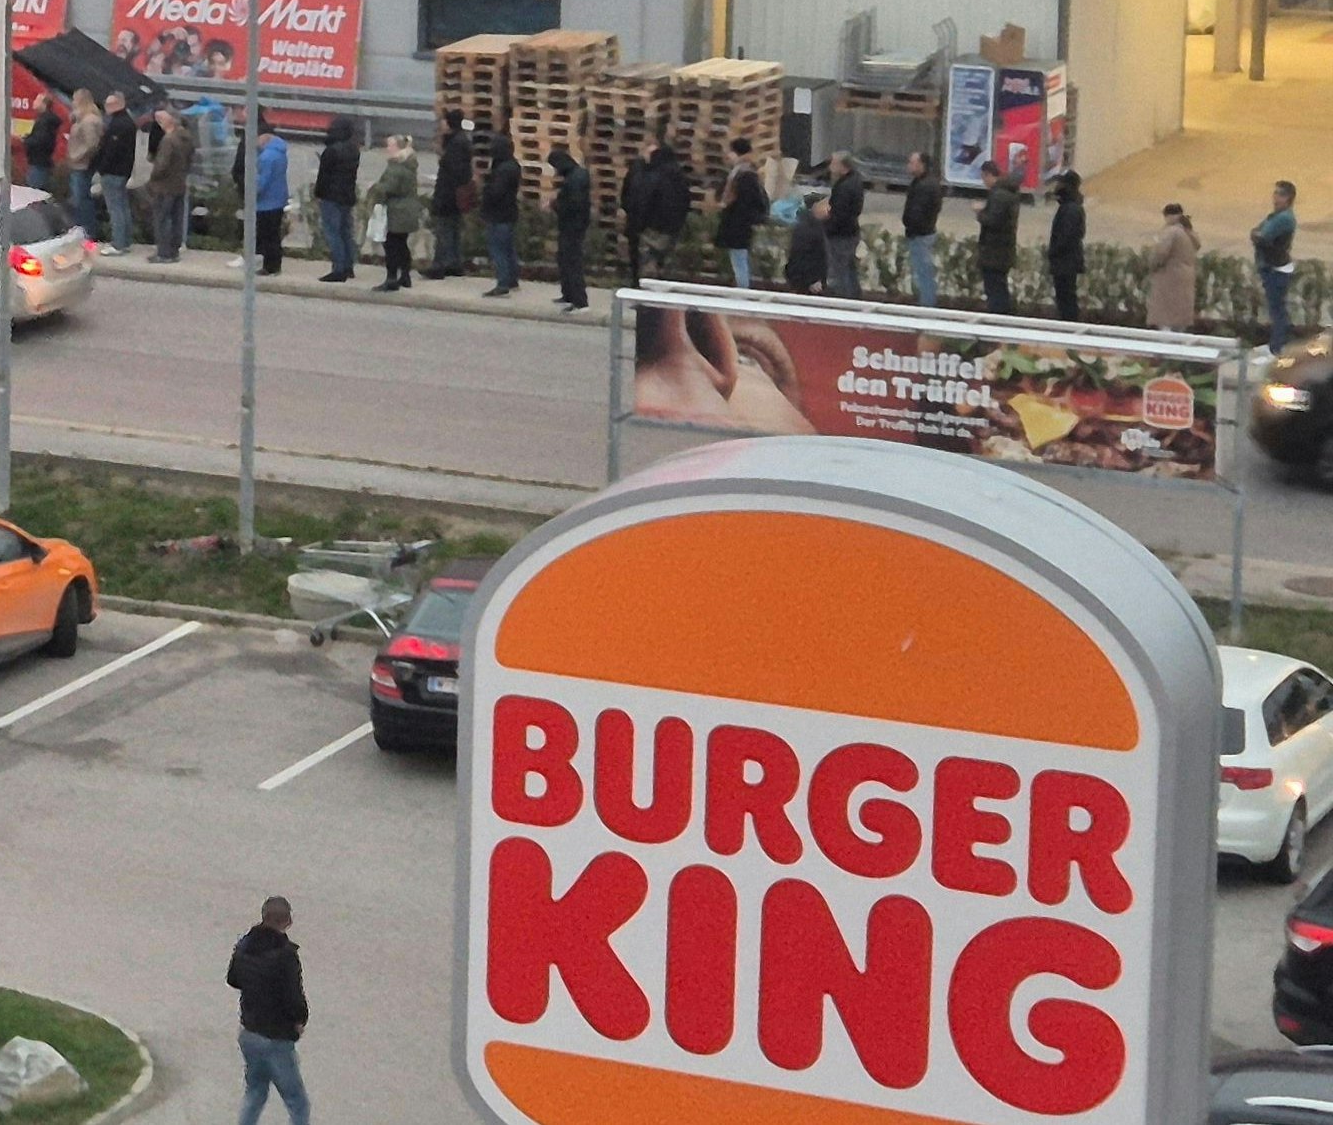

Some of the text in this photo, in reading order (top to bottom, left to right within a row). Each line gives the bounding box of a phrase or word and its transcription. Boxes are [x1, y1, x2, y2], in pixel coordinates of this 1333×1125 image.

[272, 39, 335, 59] Weitere
[852, 345, 983, 380] Schnüffel
[837, 370, 999, 409] den Trüffel.
[1146, 403, 1190, 418] KING
[491, 694, 1133, 915] BURGER
[486, 836, 1126, 1115] KING
